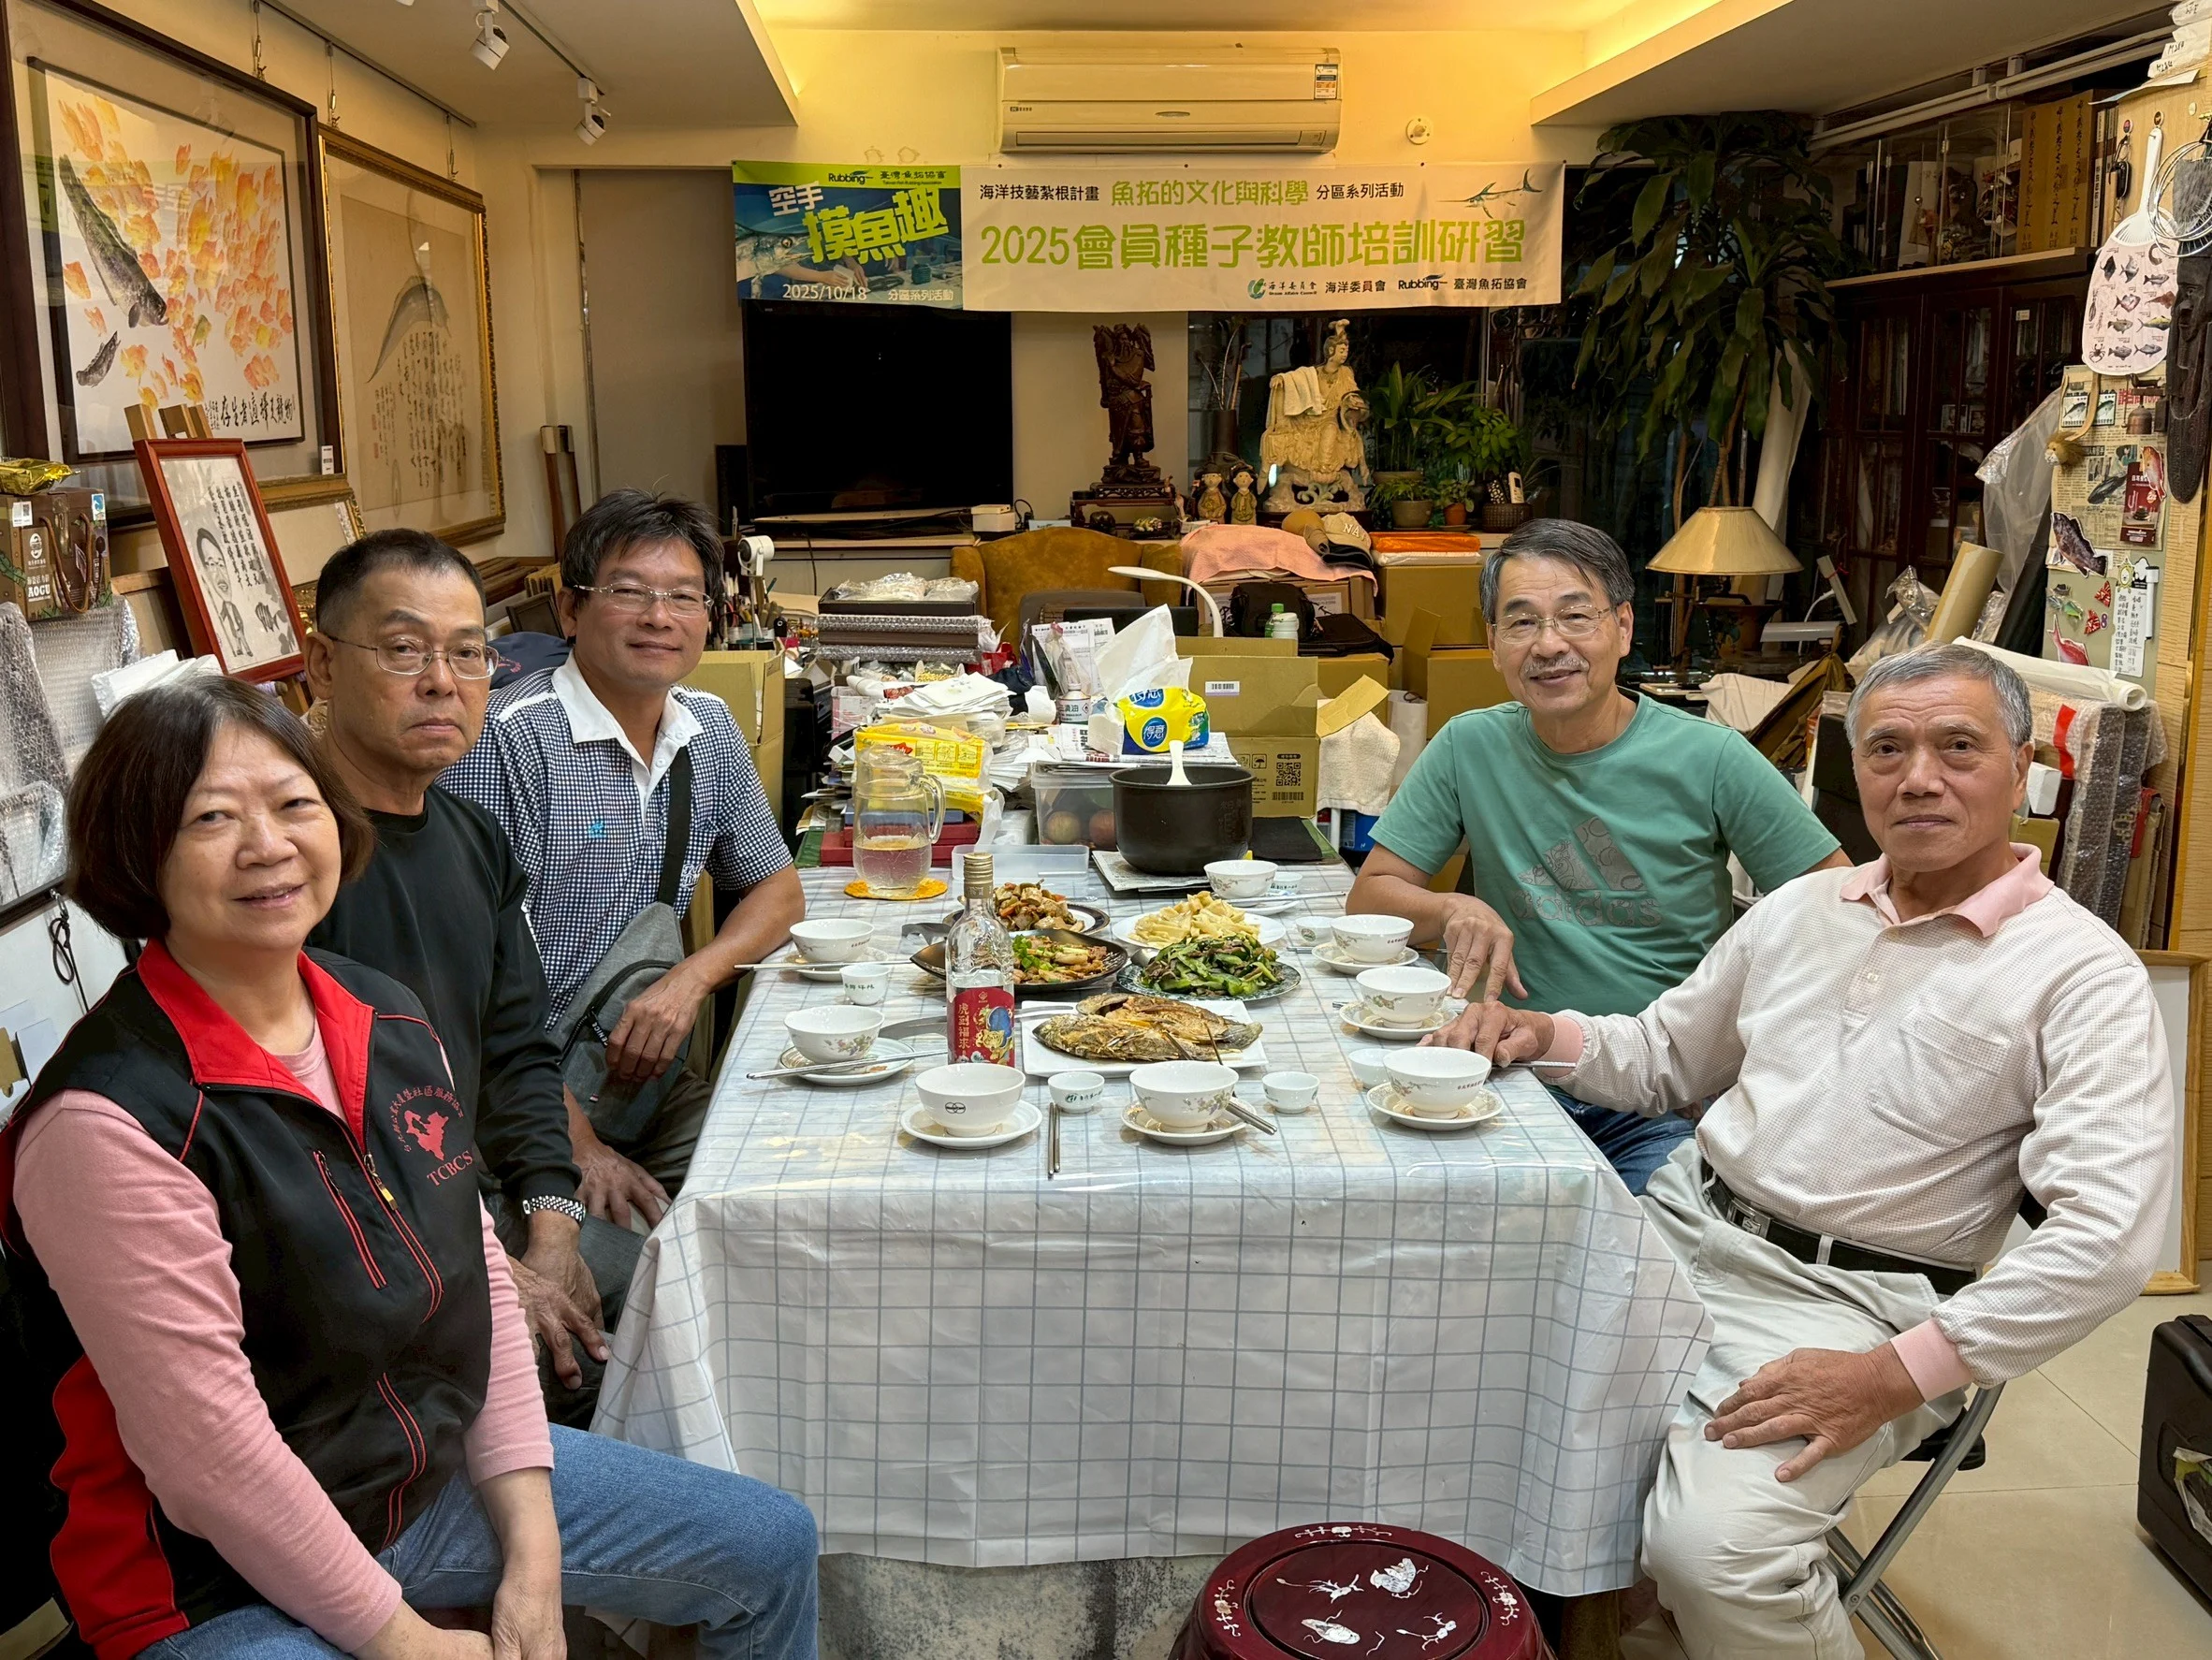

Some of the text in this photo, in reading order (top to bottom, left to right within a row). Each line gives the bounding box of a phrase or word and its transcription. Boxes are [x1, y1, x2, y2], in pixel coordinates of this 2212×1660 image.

[828, 171, 866, 185] Rubbing
[768, 181, 824, 217] 空手
[980, 179, 1404, 208] 海洋技藝紮根計畫 魚拓的文化與科學 分區系列活動
[802, 186, 950, 265] 摸魚趣
[981, 218, 1526, 271] 2025會員種子教師培訓研習
[782, 284, 867, 301] 2025/10/18
[1325, 281, 1387, 293] 海洋委員會
[1398, 277, 1439, 292] Rubbing
[1453, 278, 1528, 291] 臺灣魚拓協會
[888, 288, 954, 301] 分區系列活動
[1143, 724, 1165, 740] 得意
[1511, 889, 1664, 928] adidas
[427, 1150, 473, 1187] TCBCS
